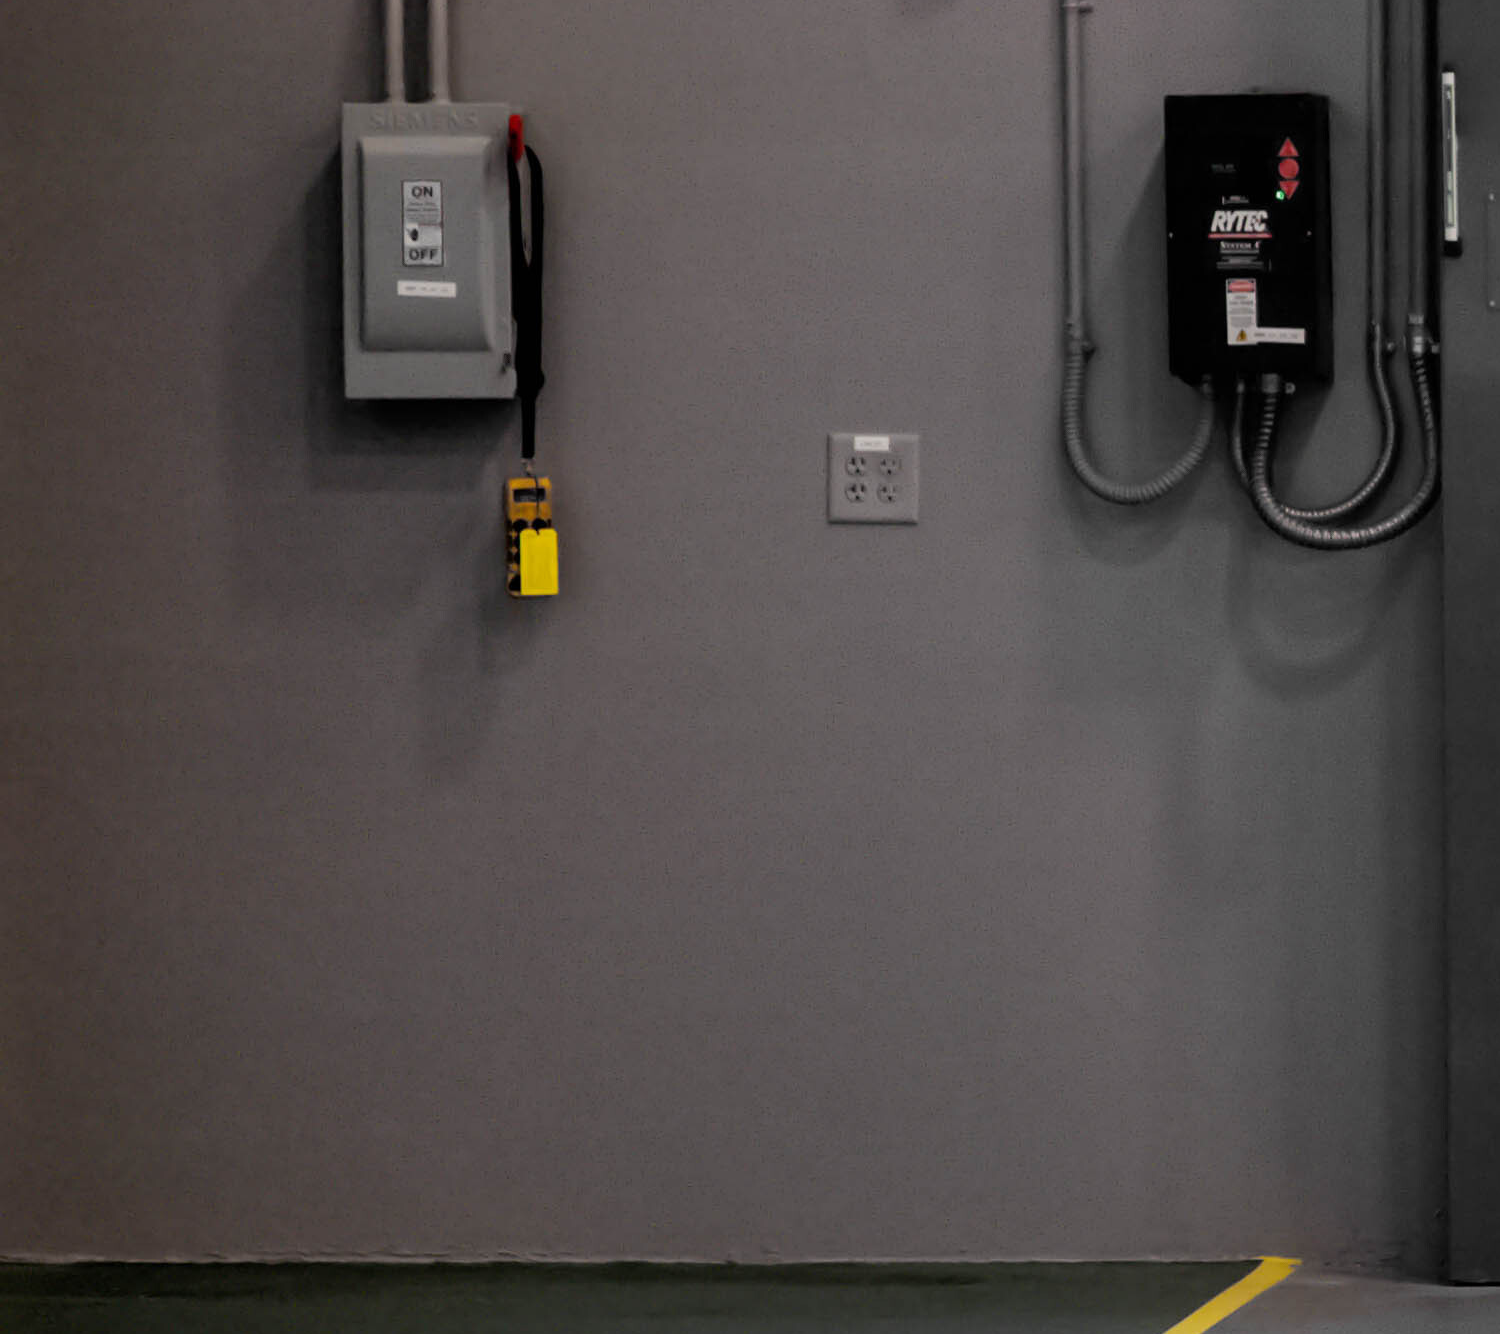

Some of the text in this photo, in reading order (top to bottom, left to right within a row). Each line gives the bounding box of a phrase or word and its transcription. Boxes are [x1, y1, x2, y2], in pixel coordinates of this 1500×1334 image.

[411, 186, 433, 198] ON
[1210, 210, 1269, 232] RYTEC
[409, 249, 440, 261] OFF
